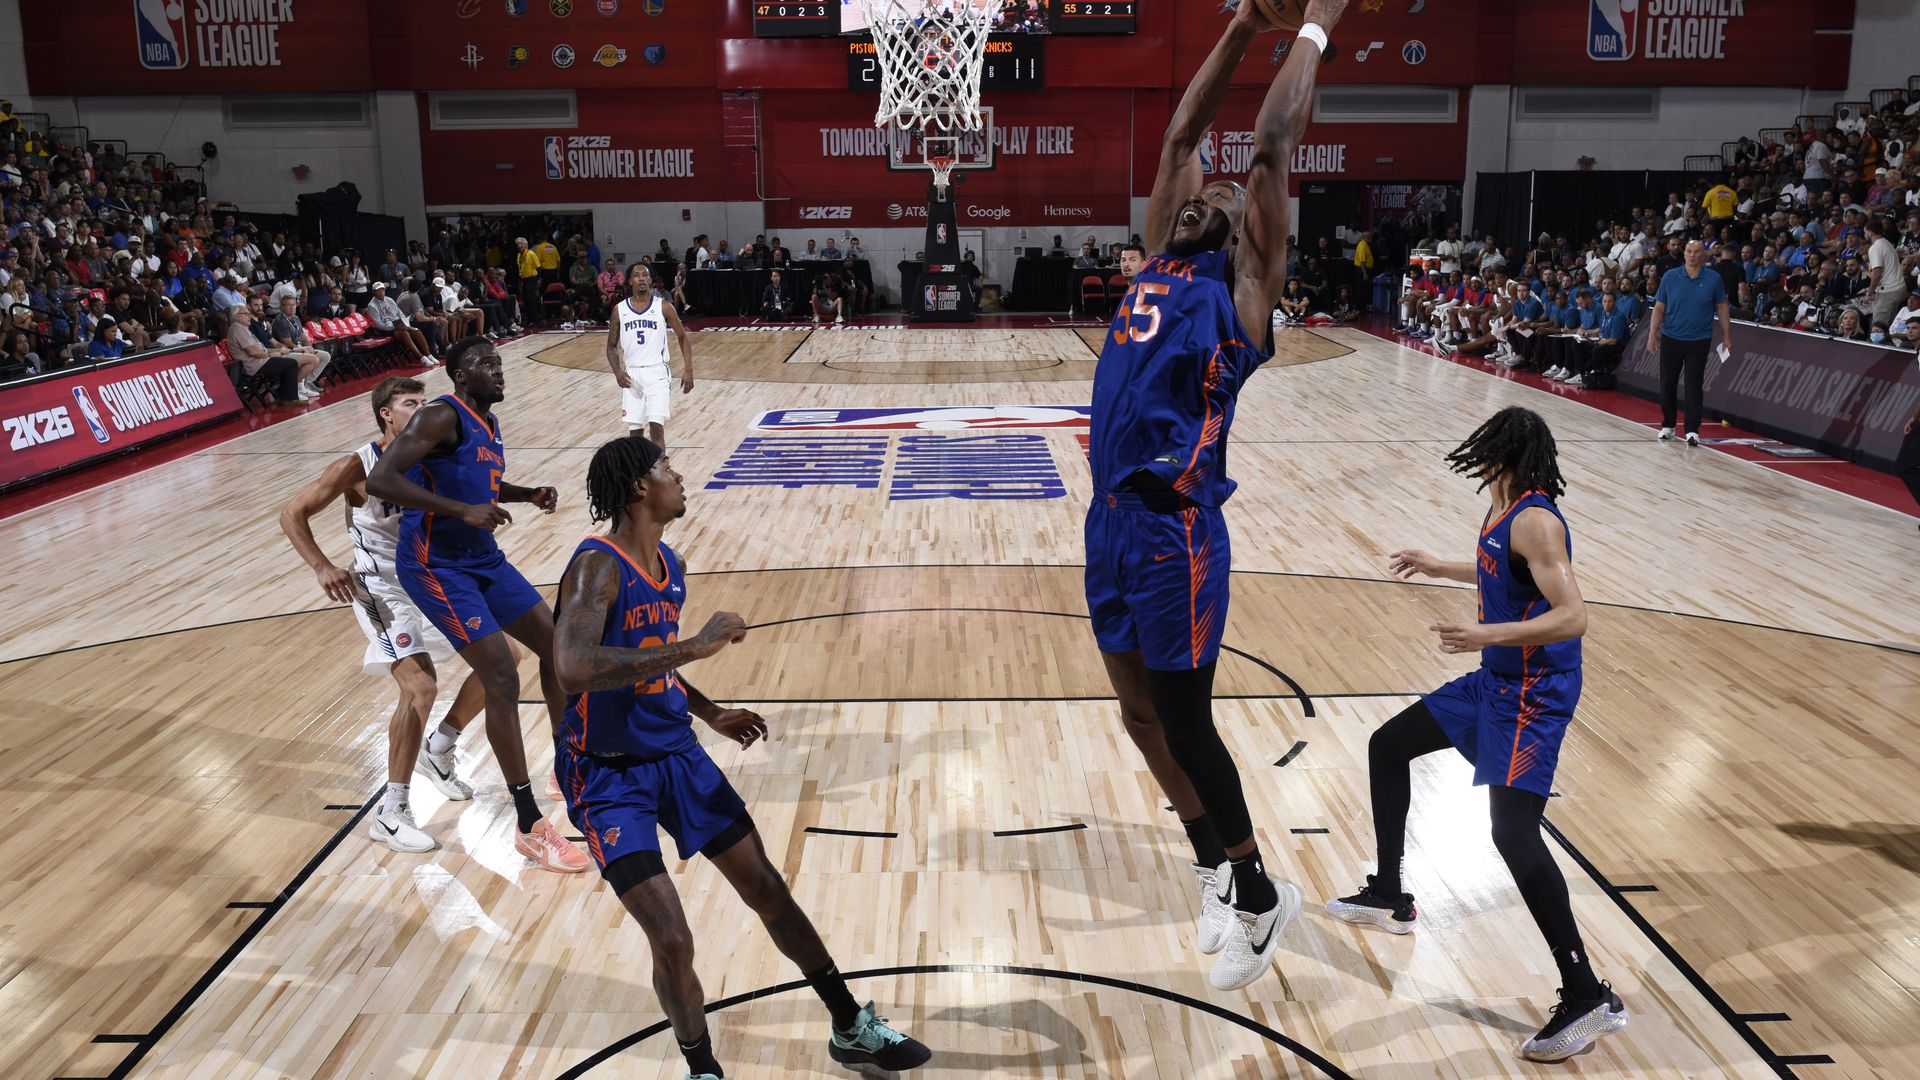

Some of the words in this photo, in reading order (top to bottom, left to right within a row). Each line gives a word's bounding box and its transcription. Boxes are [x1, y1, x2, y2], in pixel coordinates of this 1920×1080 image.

[758, 6, 770, 15] 47
[779, 7, 786, 16] 0
[798, 7, 805, 16] 2
[818, 6, 824, 16] 3
[1064, 4, 1076, 13] 55
[1085, 5, 1092, 14] 2
[1104, 5, 1111, 14] 2
[1126, 5, 1132, 14] 1
[197, 24, 282, 67] LEAGUE
[1594, 35, 1617, 53] NBA
[1645, 17, 1728, 59] LEAGUE
[146, 43, 170, 62] NBA
[850, 43, 878, 54] PISTON
[984, 41, 1013, 52] KNICKS
[1016, 58, 1034, 79] 11
[568, 136, 612, 148] 2K26
[820, 128, 926, 156] TOMORROW
[935, 126, 985, 155] TARS
[994, 127, 1029, 155] PLAY
[1037, 126, 1074, 155] HERE
[1222, 131, 1256, 143] 2K2
[568, 150, 635, 179] SUMMER
[639, 149, 694, 178] LEAGUE
[1221, 144, 1255, 173] SUM
[1290, 144, 1346, 173] LEAGUE
[1381, 194, 1406, 208] LEAGUE
[806, 206, 852, 219] 2K26
[905, 206, 928, 217] AT&
[967, 205, 1011, 220] Google
[1044, 204, 1093, 218] Hennessy
[938, 291, 961, 301] SUMMER
[938, 301, 957, 310] LEAGUE
[1113, 282, 1170, 346] 55
[625, 320, 657, 331] PISTONS
[637, 331, 645, 345] 5
[1730, 353, 1800, 402] TICKETS
[1787, 367, 1825, 410] ON
[1812, 370, 1874, 420] SALE
[98, 374, 172, 432] SUMMER
[155, 364, 214, 416] LEAGUE
[3, 406, 75, 451] 2K26
[704, 436, 889, 489] LEAGUE
[890, 435, 1067, 500] SUMMER
[623, 602, 660, 631] NEW
